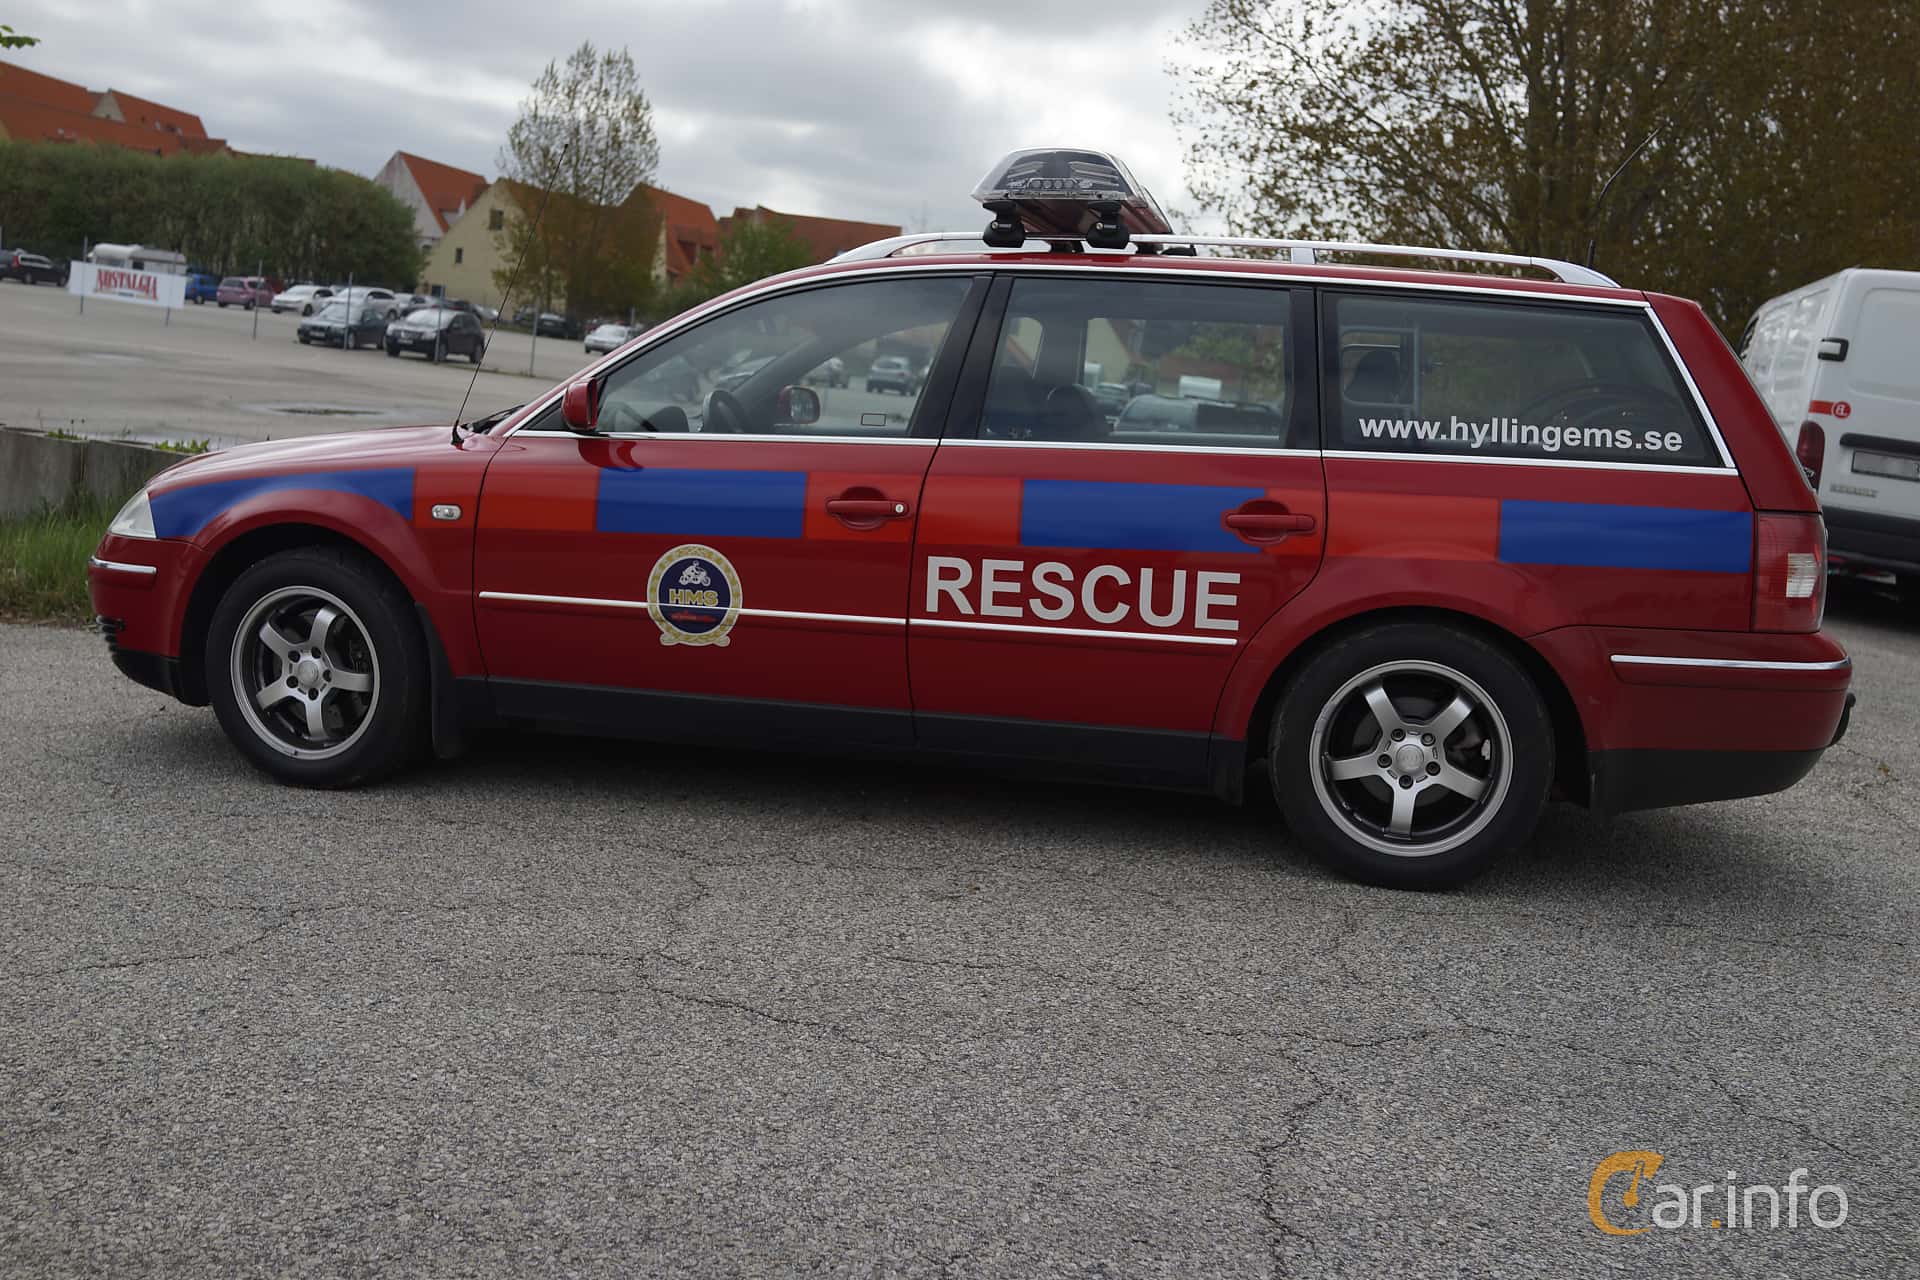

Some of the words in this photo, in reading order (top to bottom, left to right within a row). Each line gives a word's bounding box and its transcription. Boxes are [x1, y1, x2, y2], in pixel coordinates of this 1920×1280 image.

[95, 268, 158, 301] NOSTALGIA
[1359, 415, 1683, 452] www.hyllingems.se
[669, 588, 719, 607] HMS
[926, 555, 1241, 631] RESCUE
